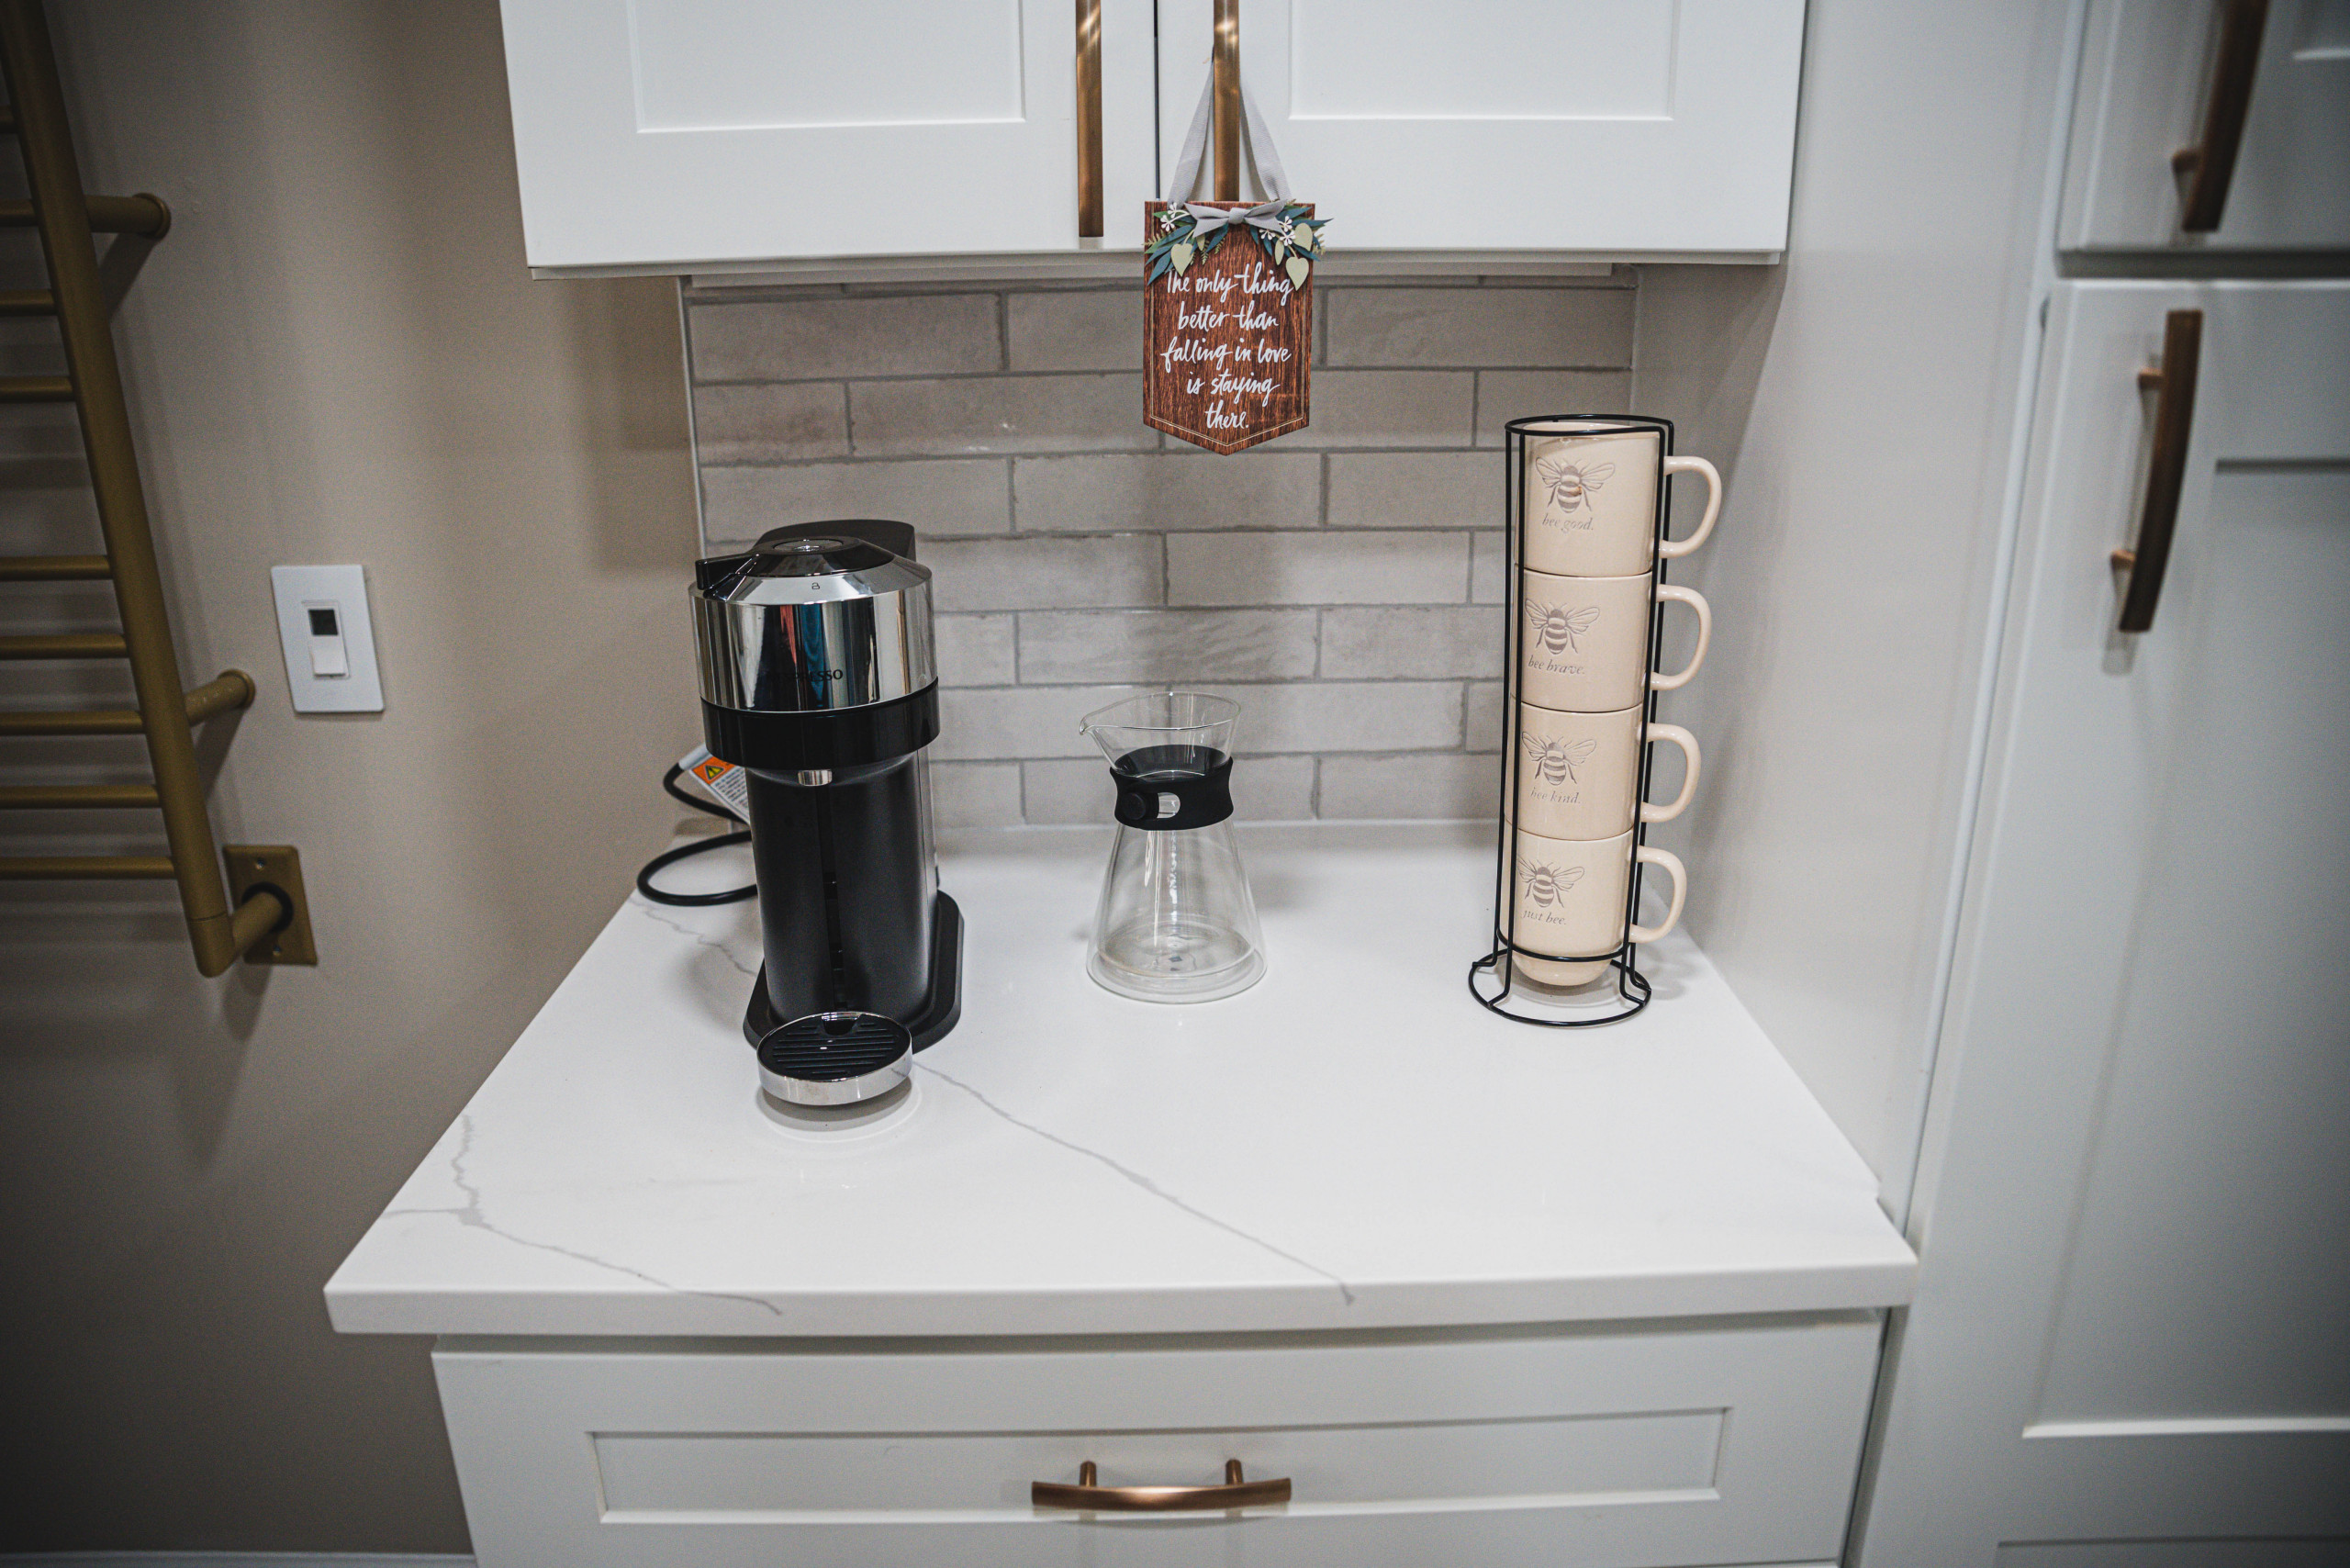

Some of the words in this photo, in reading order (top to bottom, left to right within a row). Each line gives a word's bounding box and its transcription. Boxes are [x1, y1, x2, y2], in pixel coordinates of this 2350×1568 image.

[1196, 269, 1238, 303] only
[1234, 262, 1293, 306] thing
[1178, 300, 1230, 331] better
[1233, 300, 1280, 330] than
[1160, 336, 1233, 373] falling
[1235, 338, 1251, 362] in
[1258, 338, 1292, 364] love
[1187, 372, 1205, 395] is
[1211, 368, 1281, 407] staying
[1204, 399, 1249, 430] there.
[1542, 513, 1561, 528] bee
[1561, 517, 1594, 533] good.
[1528, 655, 1544, 670] bee
[1546, 659, 1585, 675] brave.
[1530, 787, 1548, 800] bee
